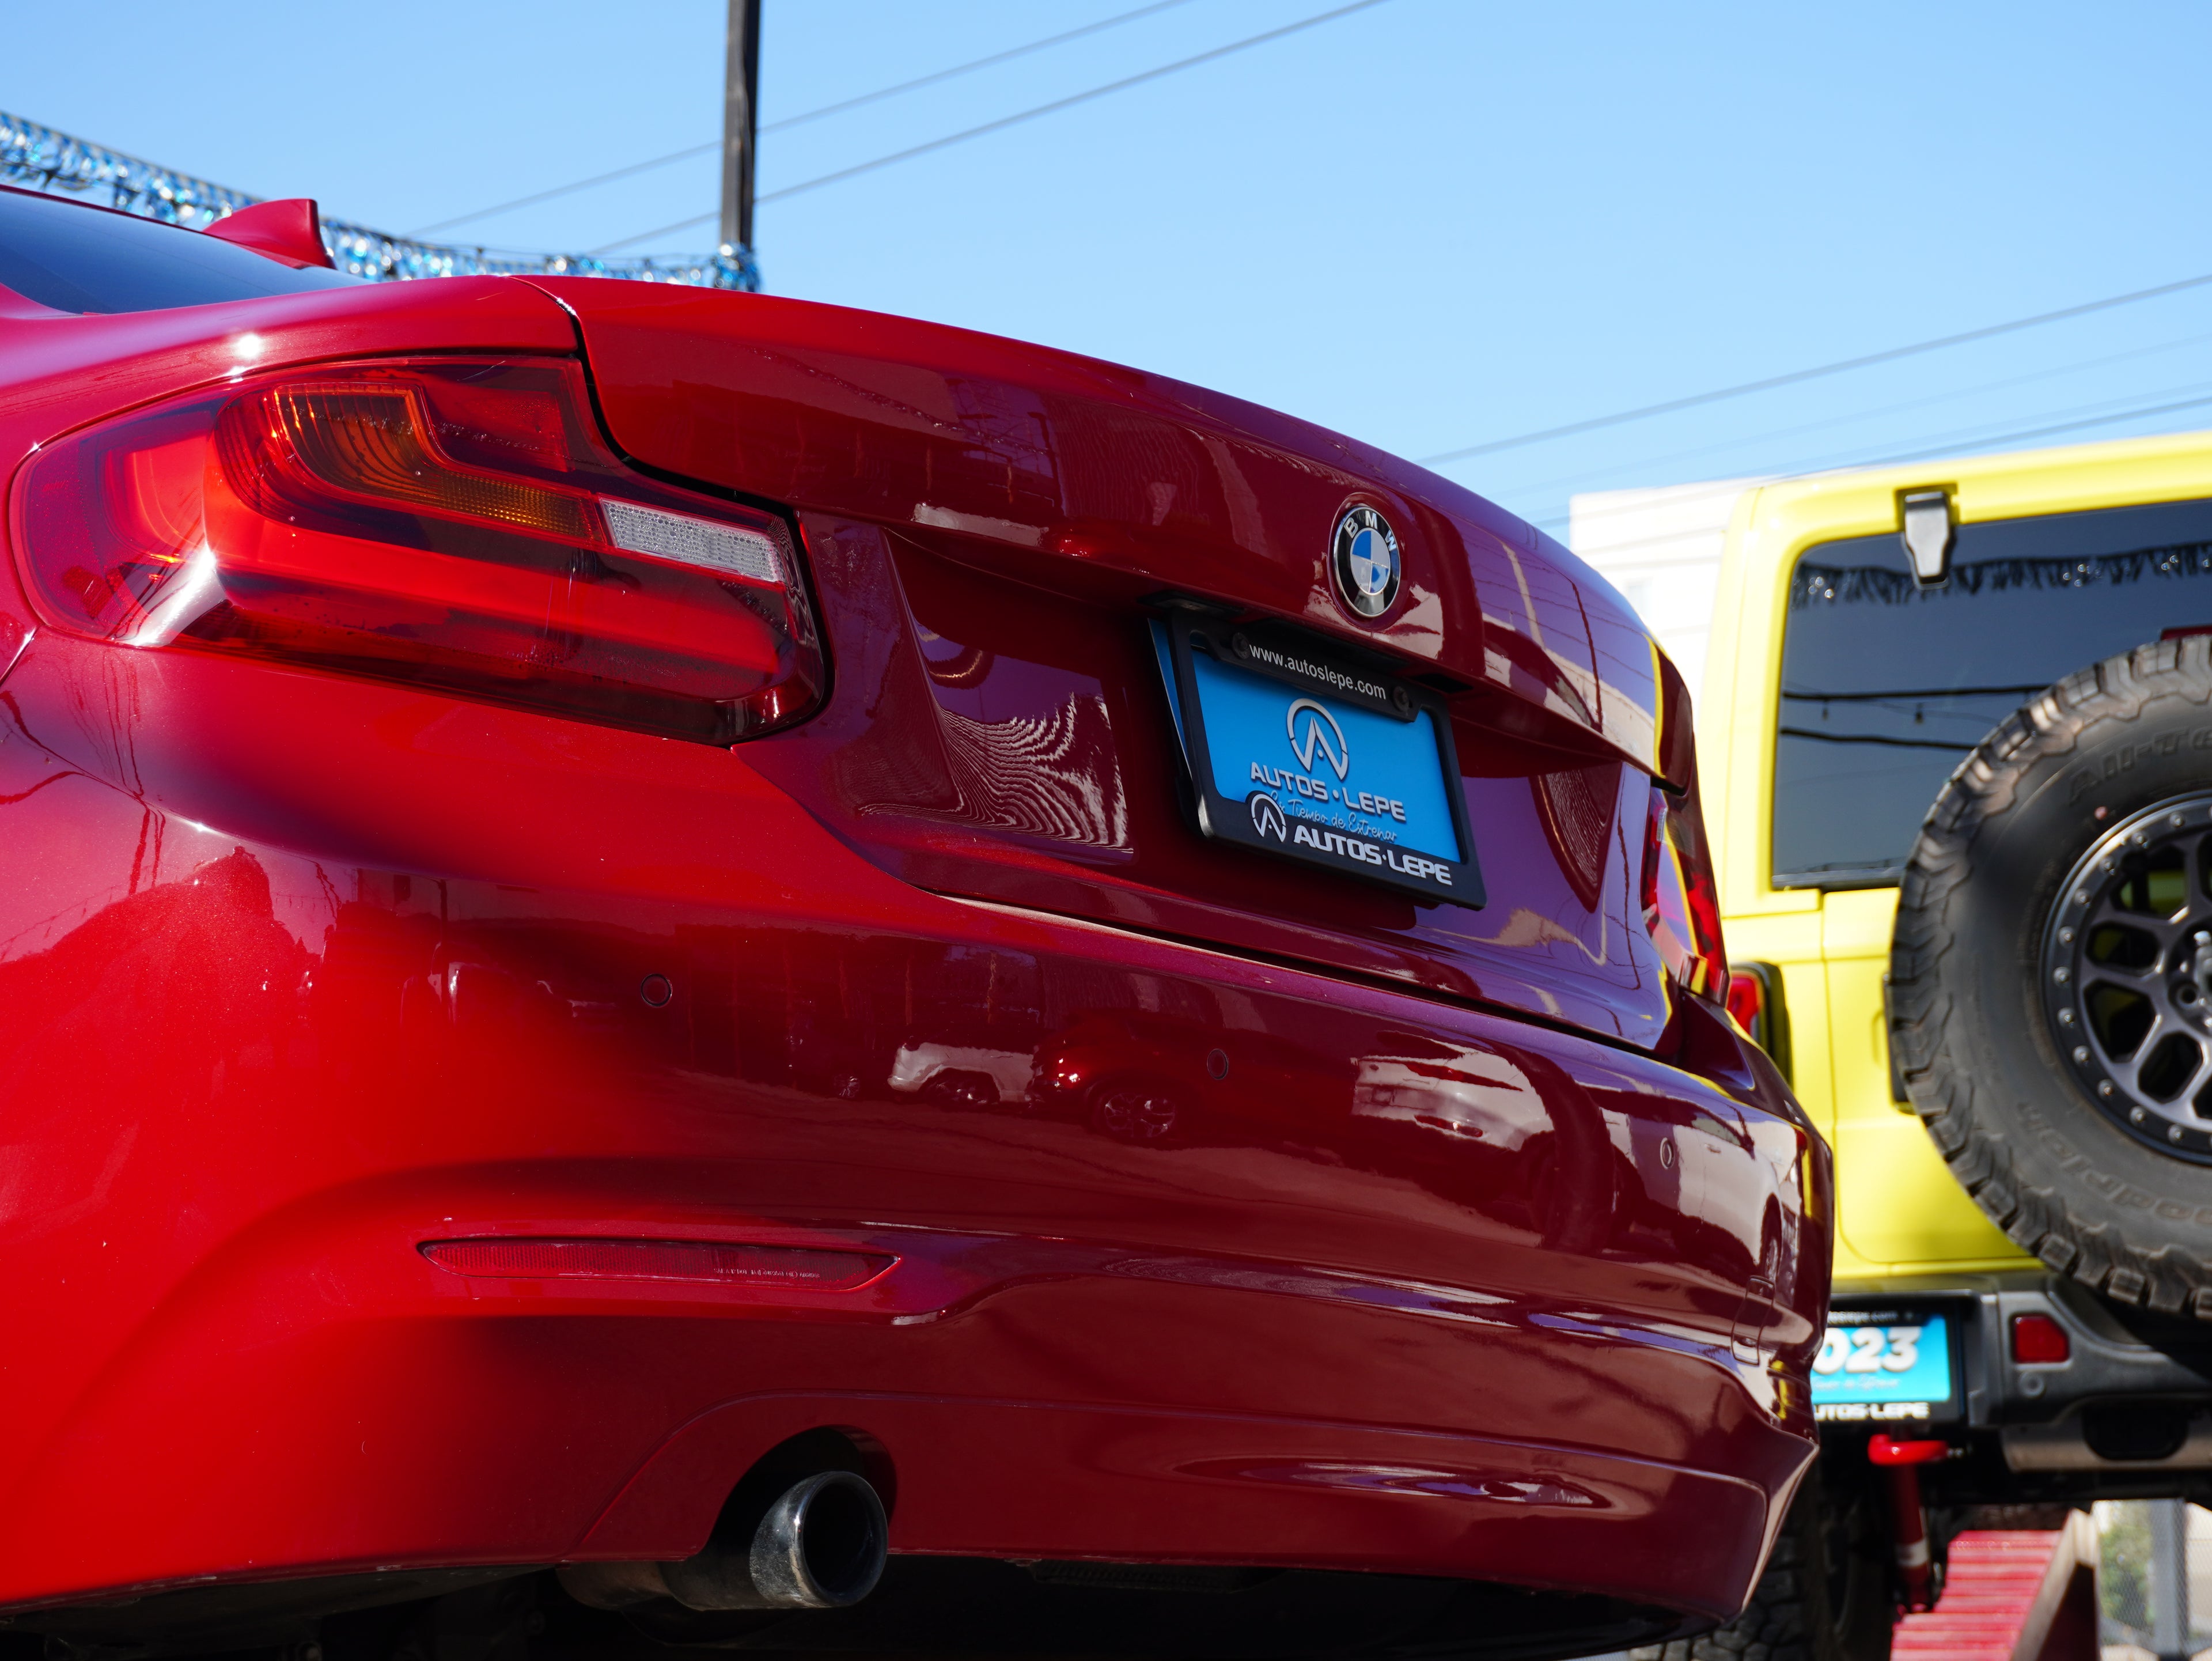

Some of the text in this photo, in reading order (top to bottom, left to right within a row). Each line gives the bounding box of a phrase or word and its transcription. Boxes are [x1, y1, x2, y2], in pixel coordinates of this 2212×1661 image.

[1343, 510, 1397, 551] BMW
[1249, 644, 1387, 700] www.autoslepe.com
[1287, 798, 1328, 823] Tiempo
[1331, 811, 1346, 829] de
